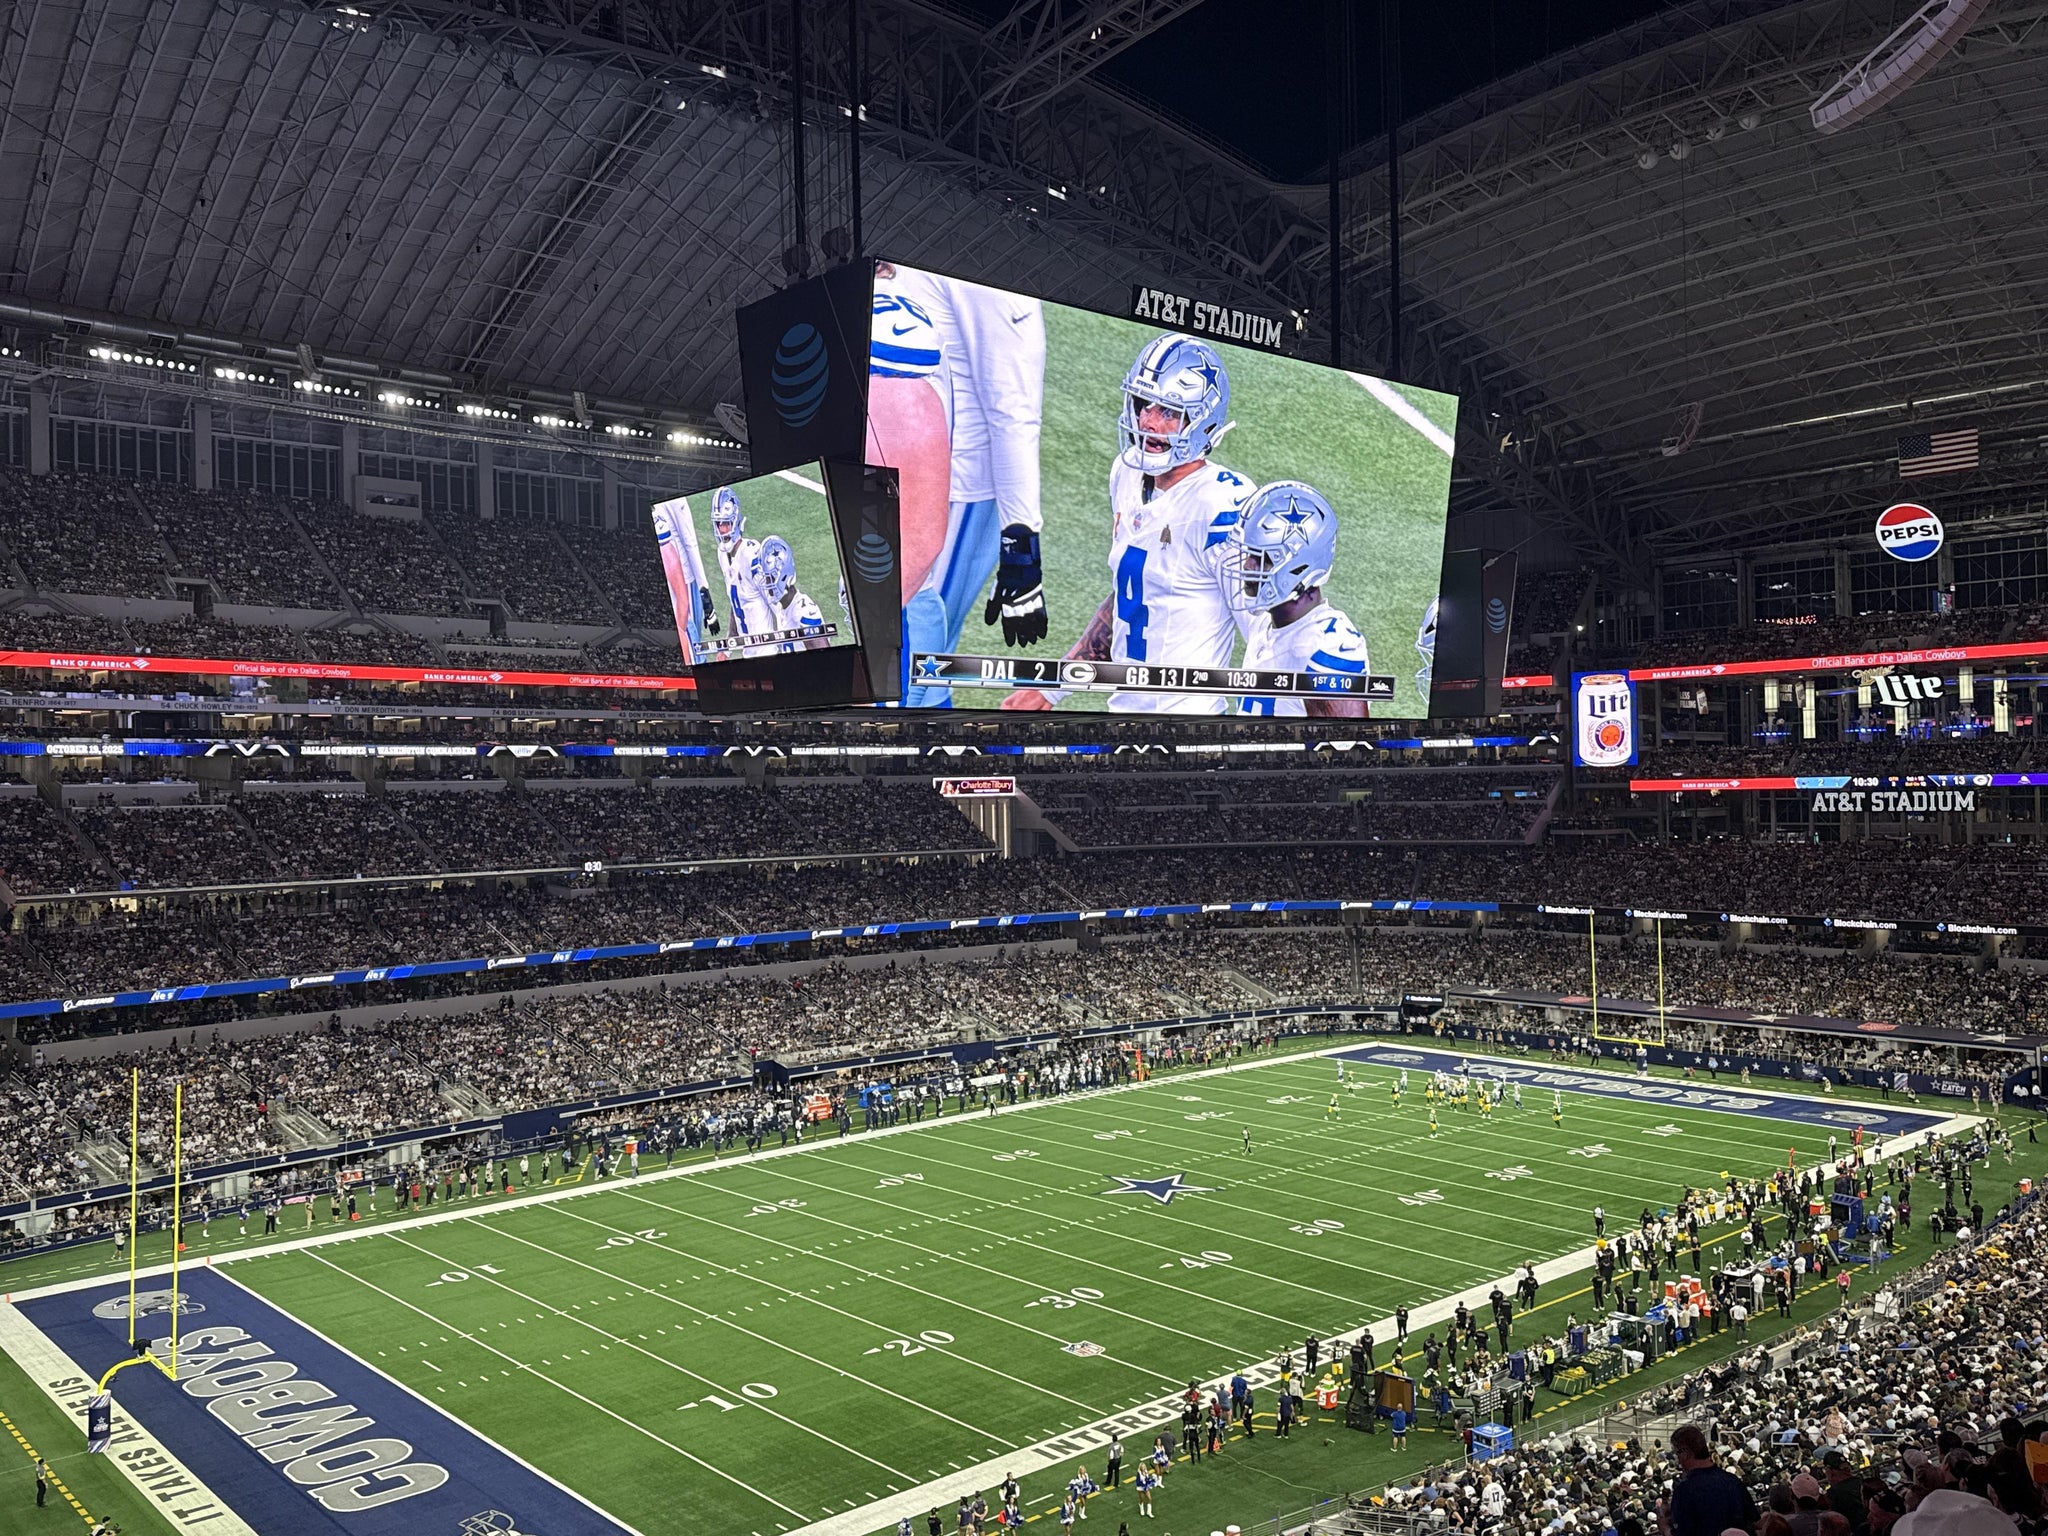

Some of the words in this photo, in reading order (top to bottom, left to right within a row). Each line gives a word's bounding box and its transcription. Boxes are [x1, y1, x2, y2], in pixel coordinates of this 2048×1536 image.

[1135, 287, 1191, 325] AT&T
[1194, 301, 1283, 348] STADIUM
[1880, 524, 1939, 541] PEPSI
[1116, 545, 1148, 662] 4
[90, 660, 131, 668] AMERICA
[1812, 656, 1842, 667] Official
[1845, 655, 1865, 665] Bank
[1868, 655, 1878, 664] of
[1880, 654, 1894, 663] the
[1897, 652, 1922, 662] Dallas
[1925, 649, 1967, 660] Cowboys
[233, 664, 258, 672] Official
[260, 665, 277, 673] Bank
[300, 667, 319, 675] Dallas
[321, 668, 351, 677] Cowboys
[981, 659, 1017, 681] DAL
[1033, 662, 1044, 681] 2
[1126, 666, 1149, 685] GB
[1159, 669, 1177, 687] 13
[1192, 671, 1208, 685] 2ND
[1227, 671, 1257, 686] 10:30
[1274, 675, 1288, 687] :25
[1312, 676, 1328, 688] 1ST
[1329, 680, 1337, 688] &
[1340, 677, 1352, 689] 10
[1870, 675, 1943, 707] Lite
[12, 698, 45, 706] RENFRO
[1587, 694, 1628, 718] Lite
[46, 745, 88, 754] OCTOBER
[102, 745, 124, 754] 2025
[301, 746, 330, 755] DALLAS
[377, 746, 425, 755] WASHINGTON
[961, 780, 991, 789] Charlotte
[991, 780, 1012, 789] Tilbury
[1818, 778, 1824, 786] 2
[1852, 777, 1879, 787] 10:30
[1953, 776, 1965, 785] 13
[1812, 792, 1865, 812] AT&T
[1871, 791, 1975, 812] STADIUM
[1634, 909, 1687, 920] Blockchain.com
[1730, 914, 1788, 924] Blockchain.com
[1834, 919, 1897, 930] Blockchain.com
[1948, 924, 2017, 935] Blockchain.com
[1454, 1063, 1774, 1109] COWBOYS
[1942, 1084, 1966, 1093] CATCH
[1641, 1124, 1683, 1137] 10
[1567, 1143, 1612, 1158] 20
[879, 1172, 924, 1187] 40
[1484, 1165, 1533, 1181] 30
[751, 1198, 807, 1214] 30
[1398, 1189, 1445, 1206] 40
[1289, 1219, 1345, 1236] 50
[605, 1228, 668, 1248] 20
[1180, 1251, 1233, 1269] 40
[440, 1264, 506, 1284] 10
[1039, 1287, 1104, 1309] 30
[882, 1330, 955, 1356] 20
[49, 1377, 91, 1397] US
[700, 1382, 779, 1413] 10
[150, 1326, 450, 1512] COWBOYS
[118, 1447, 198, 1503] TAKES
[1491, 1492, 1502, 1503] 17
[172, 1503, 224, 1526] IT
